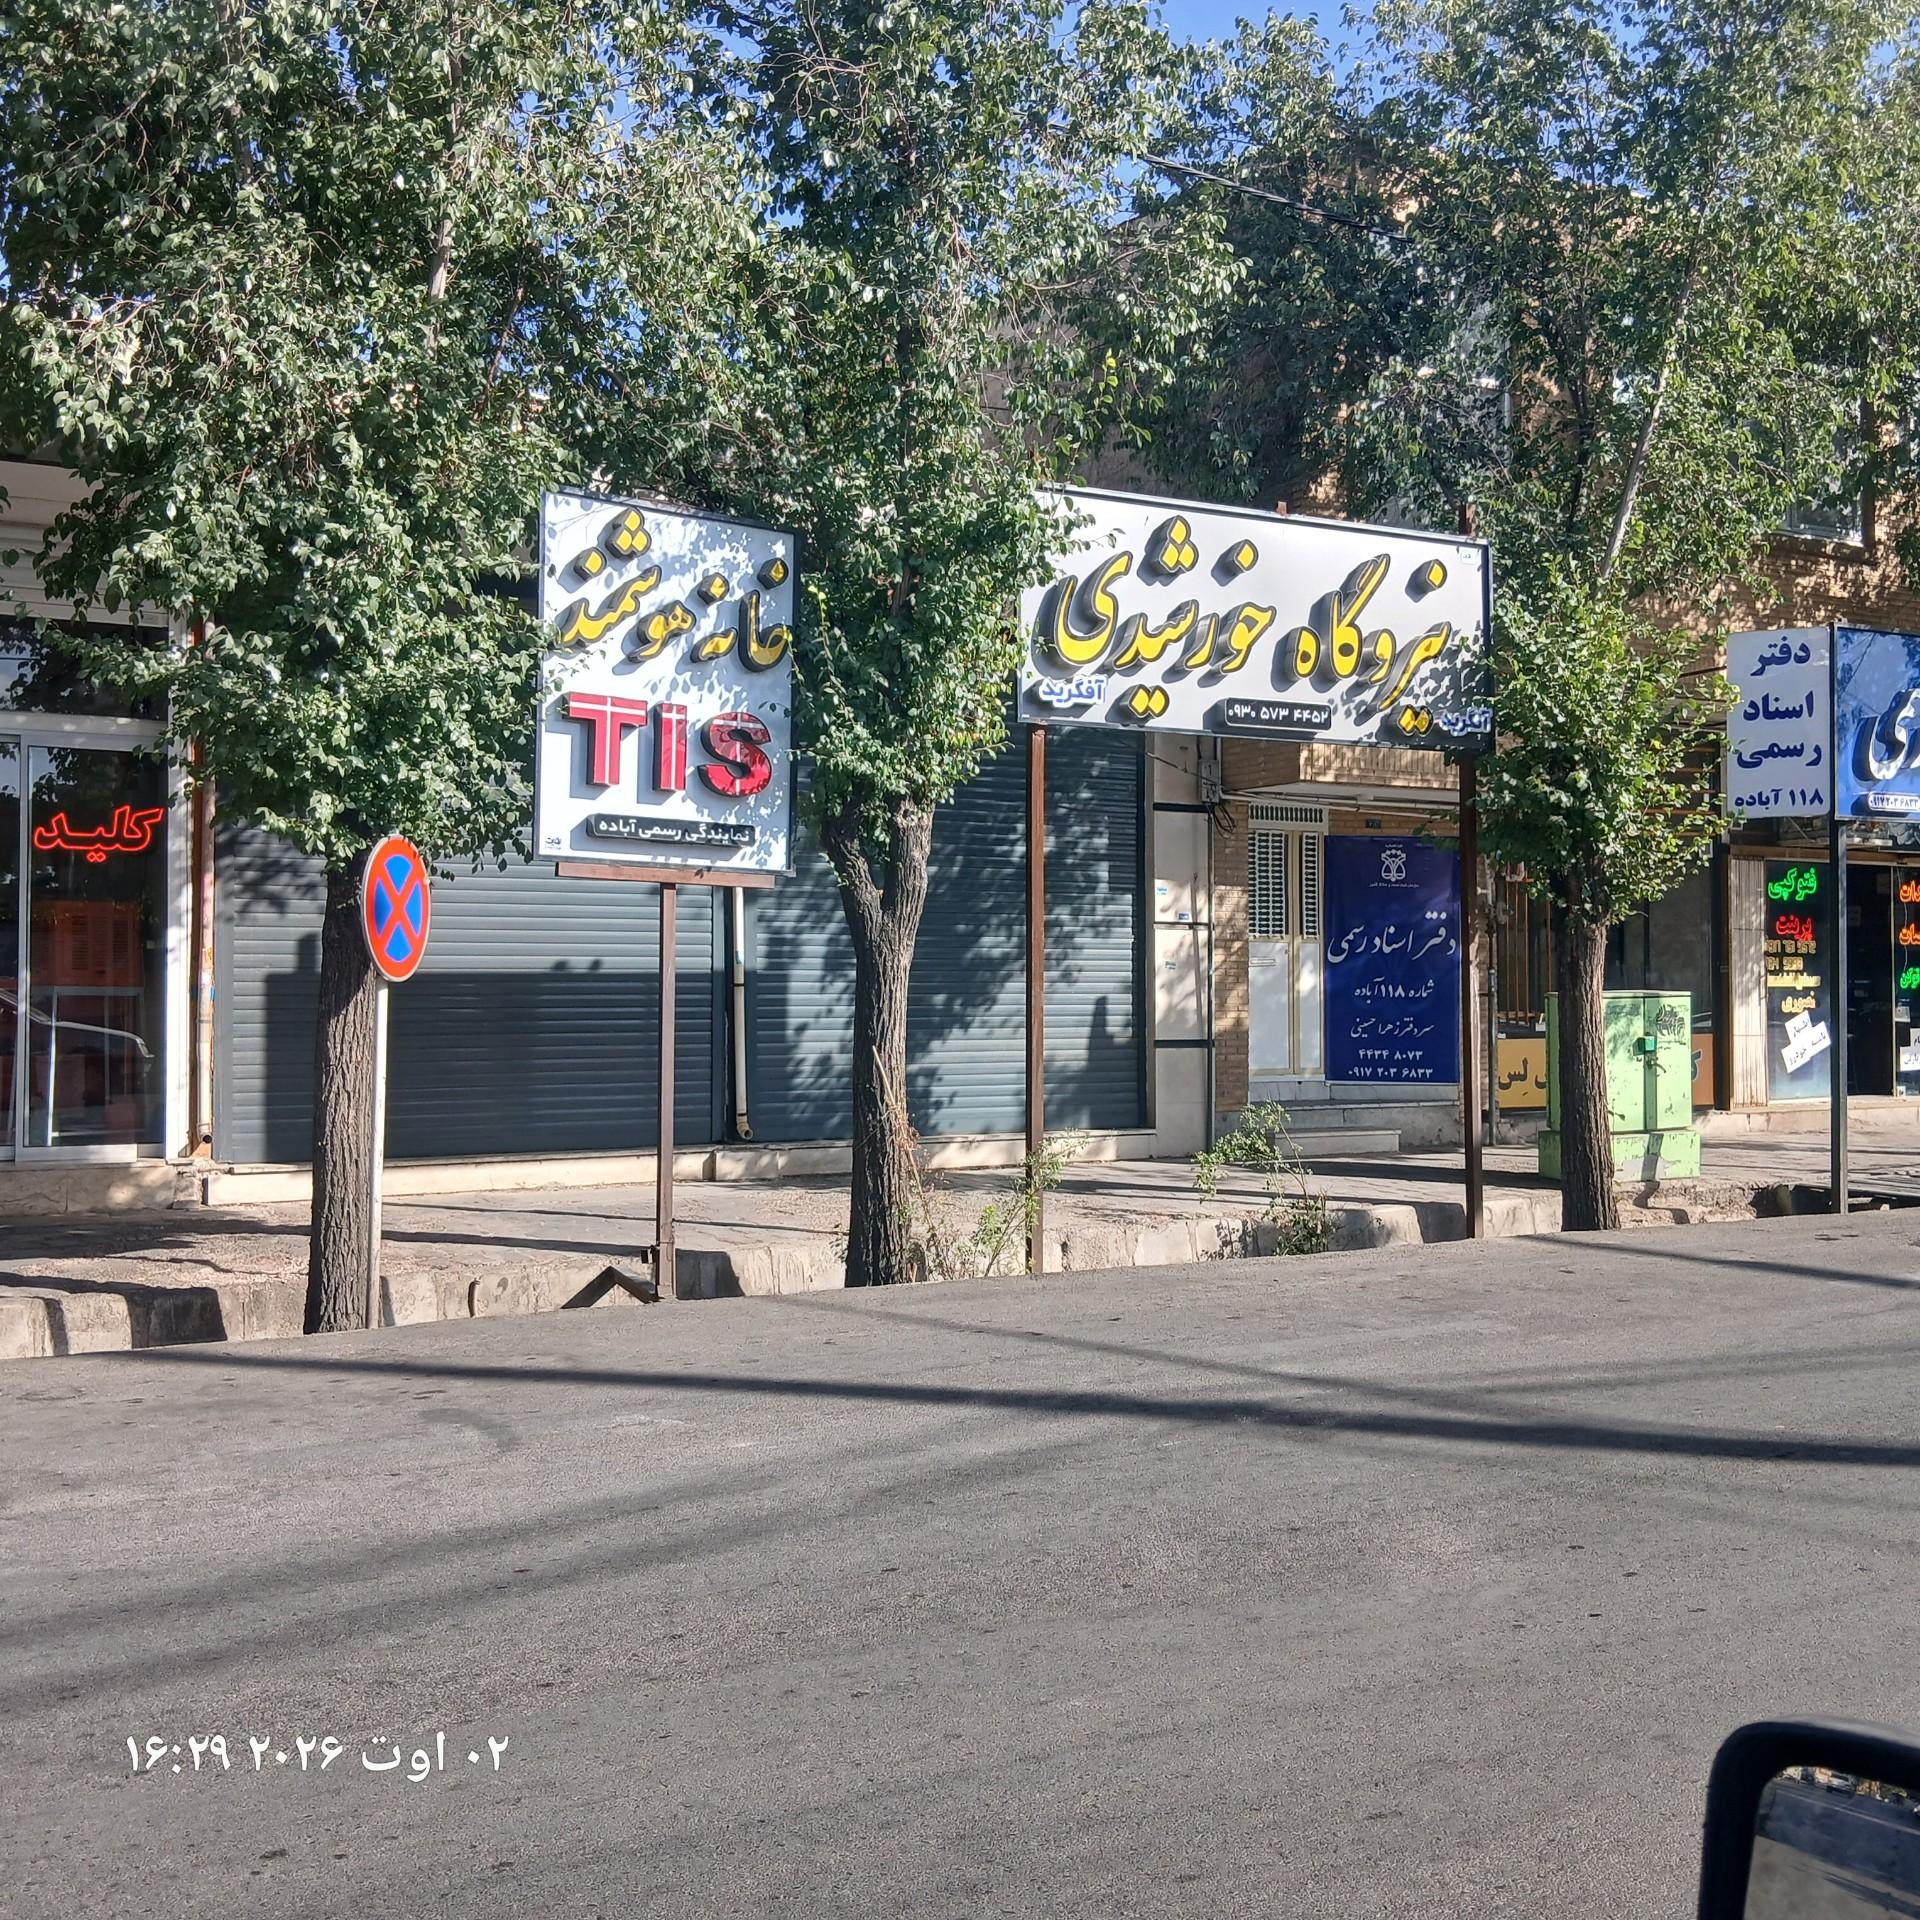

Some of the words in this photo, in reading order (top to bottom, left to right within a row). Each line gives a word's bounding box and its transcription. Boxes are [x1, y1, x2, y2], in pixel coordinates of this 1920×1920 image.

[558, 507, 696, 661] هوشمند
[692, 558, 792, 673] خانه
[1055, 515, 1278, 718] خورشیدی
[1293, 553, 1451, 735] نیروگاه
[1750, 635, 1811, 677] دفتر
[1228, 703, 1256, 718] ۰۹۳۰
[1260, 706, 1289, 721] ۵۷۳
[1293, 708, 1329, 724] ۴۴۵۲
[1742, 690, 1815, 721] اسناد
[566, 692, 772, 797] TIS
[1736, 740, 1822, 769] رسمی
[1734, 788, 1783, 810] آباده
[1788, 788, 1824, 806] ۱۱۸
[33, 804, 165, 864] کلید
[599, 818, 637, 837] آباده
[638, 825, 683, 841] رسمی
[685, 824, 750, 844] نمایندگی
[1327, 924, 1368, 964] رسمی
[1370, 925, 1414, 955] اسناد
[1411, 911, 1457, 961] دفتر
[1354, 976, 1386, 1004] آباده
[1380, 984, 1406, 998] ۱۱۸
[1408, 979, 1435, 998] شماره
[1350, 1017, 1377, 1038] حسینی
[1378, 1021, 1401, 1036] زهرا
[1358, 1048, 1390, 1060] ۴۴۳۴
[1394, 1050, 1424, 1061] ۸۰۷۳
[1347, 1066, 1373, 1078] ۰۹۱۷
[1376, 1067, 1398, 1079] ۲۰۳
[1401, 1067, 1434, 1080] ۶۸۳۳
